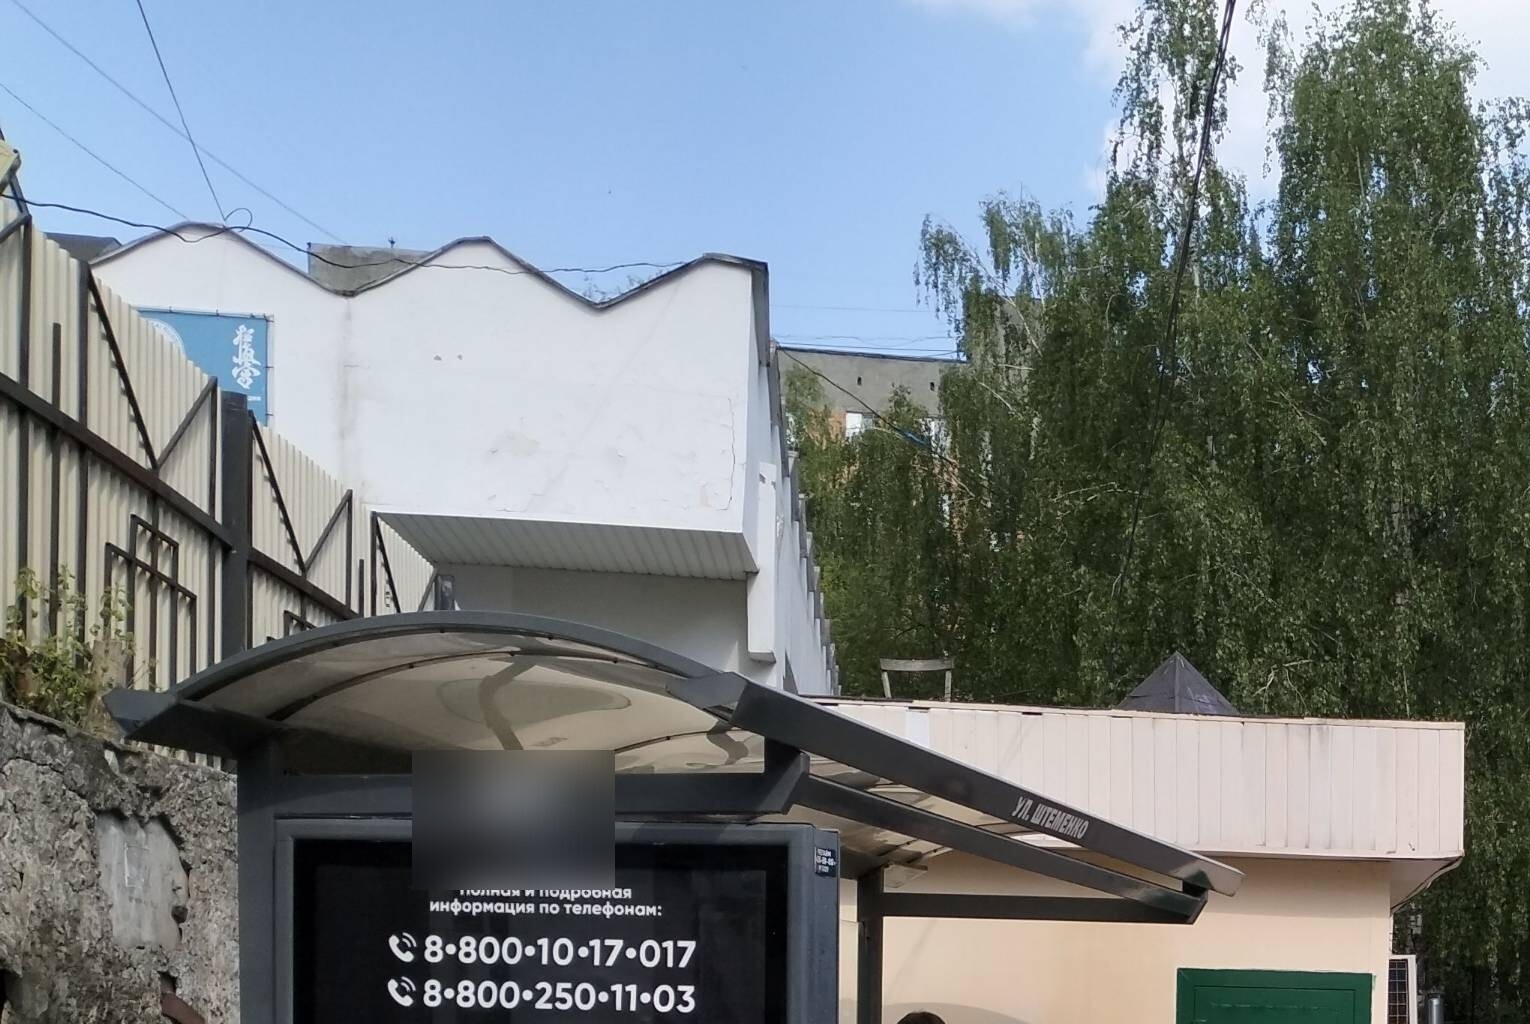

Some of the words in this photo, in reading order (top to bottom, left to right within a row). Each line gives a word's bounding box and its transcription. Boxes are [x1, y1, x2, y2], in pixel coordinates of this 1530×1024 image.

[1011, 796, 1034, 822] УЛ.
[1030, 803, 1090, 840] ШТЕМЕНКО
[429, 900, 535, 916] информация
[539, 902, 560, 915] по
[564, 902, 662, 918] телефонам:
